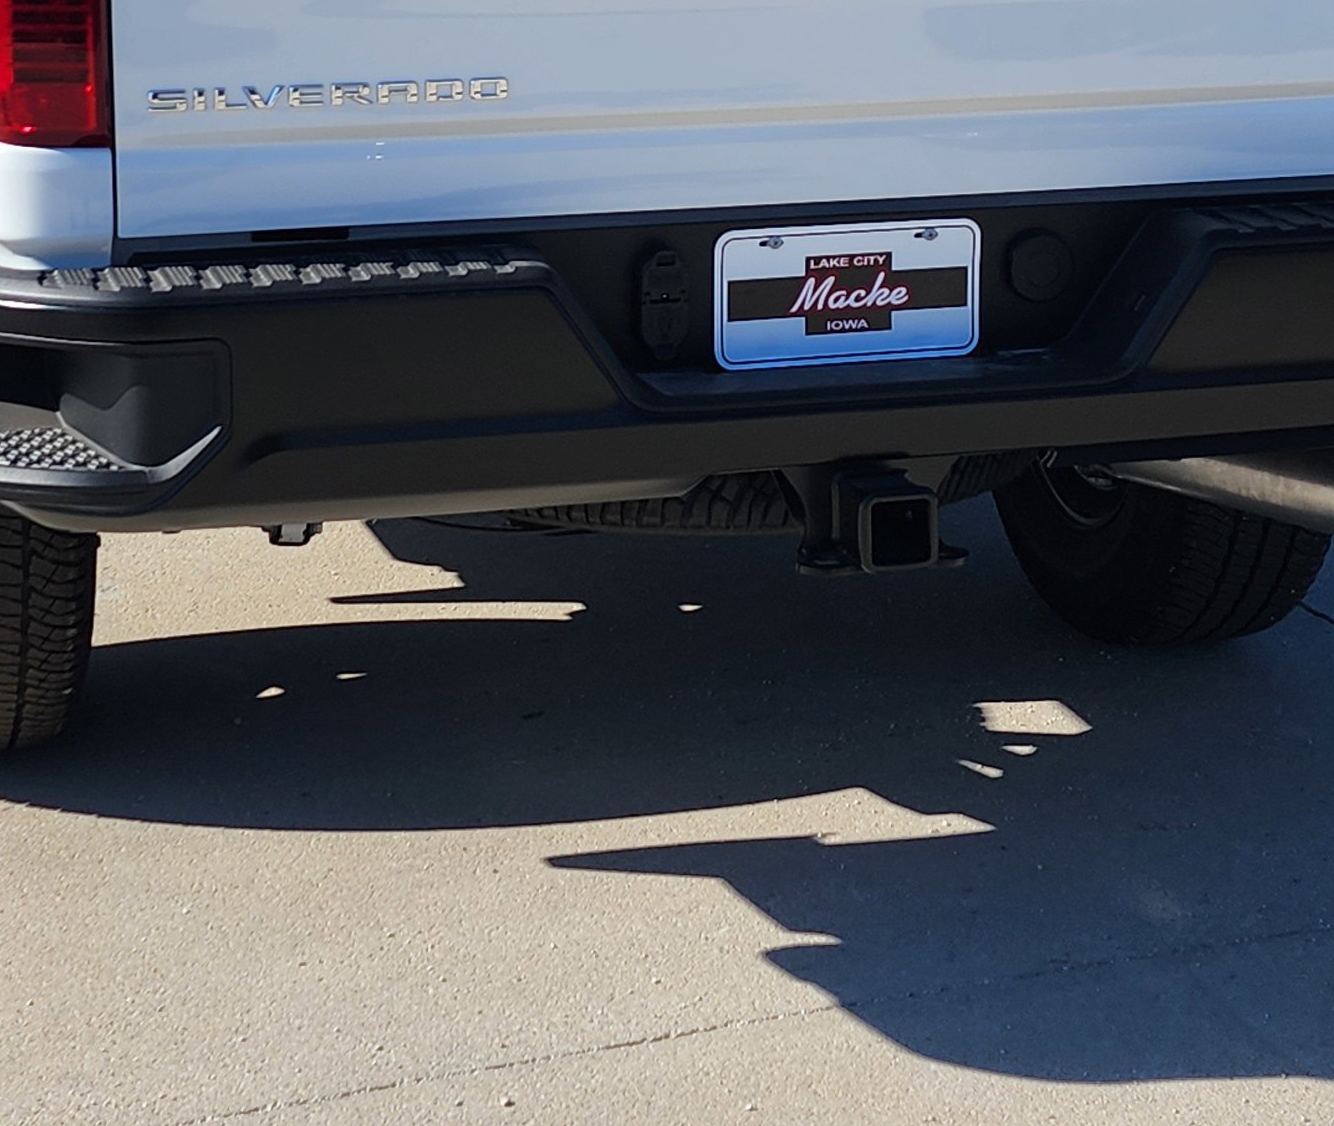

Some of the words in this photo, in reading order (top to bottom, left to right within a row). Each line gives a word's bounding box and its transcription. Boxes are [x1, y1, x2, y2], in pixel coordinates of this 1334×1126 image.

[147, 77, 509, 112] SILVERADO
[810, 257, 849, 269] LAKE
[853, 255, 887, 266] CITY
[789, 271, 909, 313] Macke
[827, 319, 868, 330] IOWA
